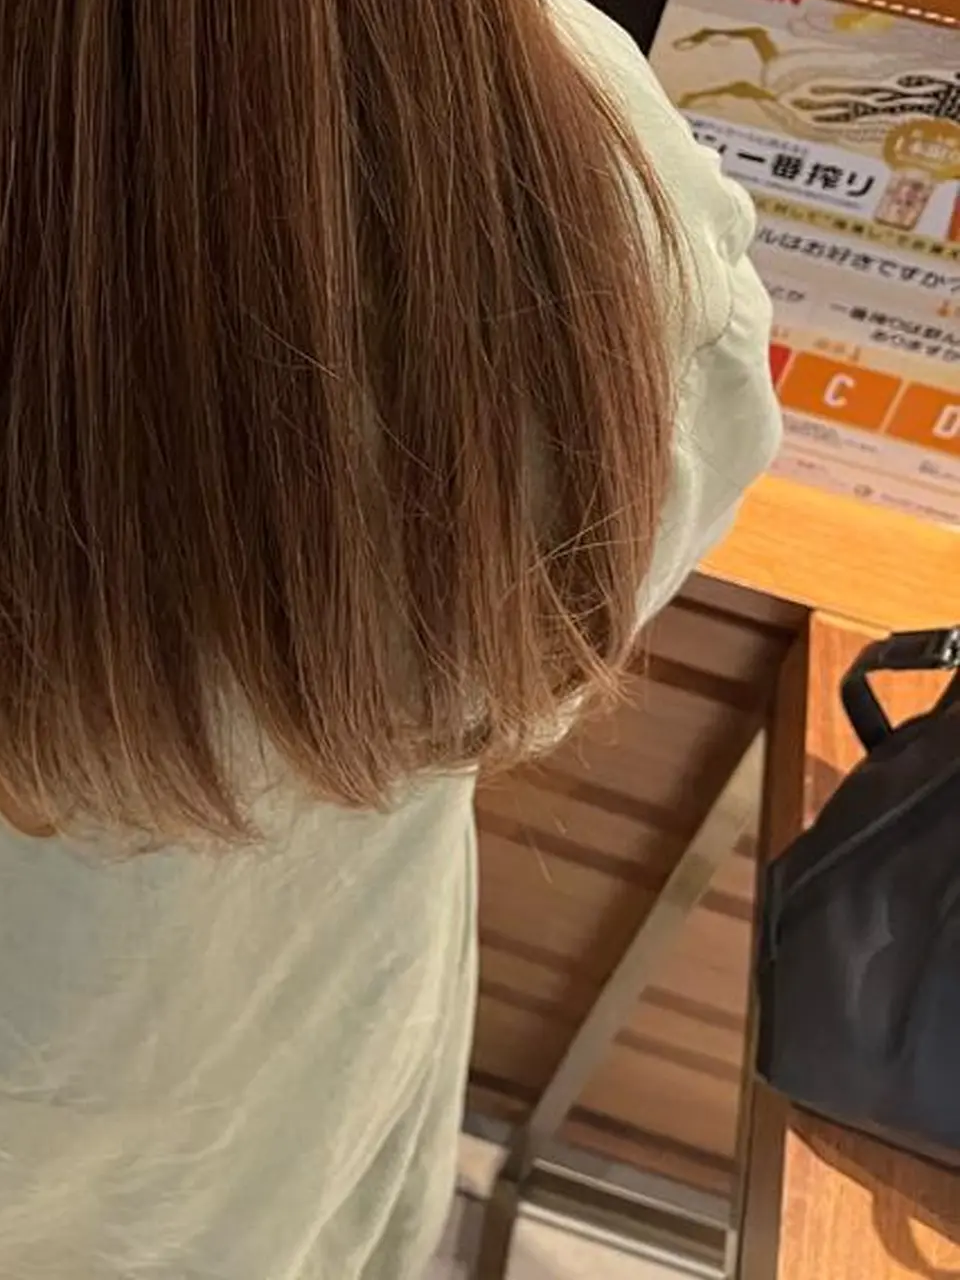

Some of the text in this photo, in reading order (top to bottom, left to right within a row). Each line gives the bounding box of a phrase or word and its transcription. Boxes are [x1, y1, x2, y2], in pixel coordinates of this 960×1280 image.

[718, 144, 875, 197] 一番搾り
[824, 372, 856, 408] C
